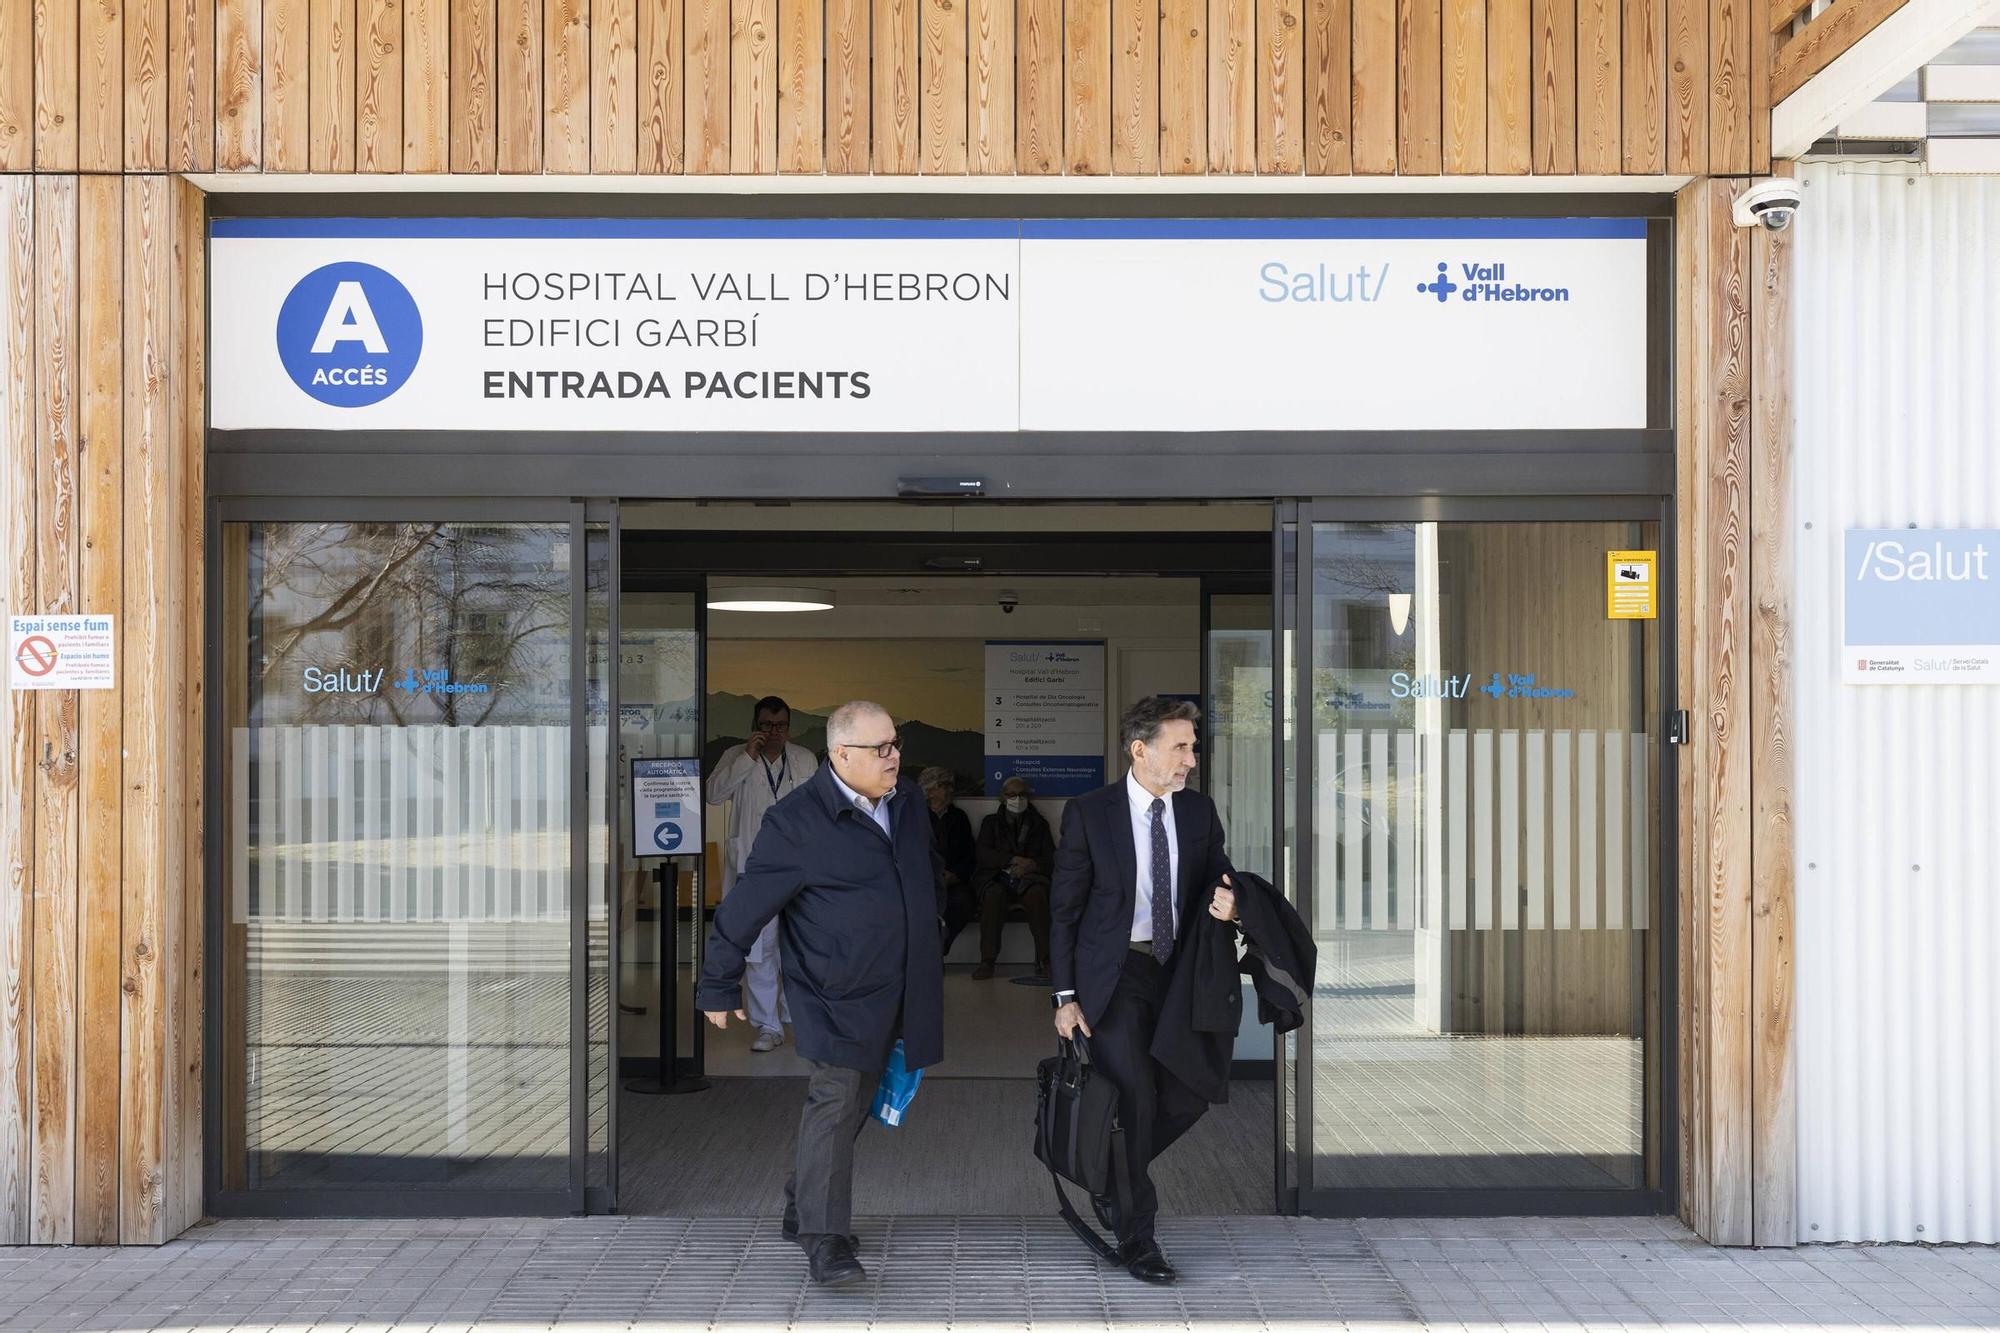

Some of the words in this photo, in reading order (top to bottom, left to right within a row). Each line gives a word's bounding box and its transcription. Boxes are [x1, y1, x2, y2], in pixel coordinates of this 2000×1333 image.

[1462, 263, 1506, 281] Vall
[484, 272, 676, 301] HOSPITAL
[691, 272, 790, 301] VALL
[805, 272, 1009, 301] D'HEBRON
[1258, 262, 1391, 303] Salut/
[1462, 283, 1569, 302] d'Hebron
[310, 280, 390, 354] A
[484, 318, 619, 347] EDIFICI
[636, 312, 760, 347] GARBÍ
[311, 364, 388, 386] ACCÉS
[483, 370, 672, 399] ENTRADA
[684, 370, 871, 399] PACIENTS
[1856, 540, 1990, 582] /Salut
[13, 619, 44, 635] Espai
[47, 621, 81, 632] sense
[84, 619, 109, 631] fum
[60, 652, 82, 660] Espacio
[303, 666, 384, 693] Salut/
[422, 669, 449, 681] Vall
[1508, 674, 1535, 686] Vall
[1390, 673, 1472, 699] Salut/
[995, 696, 1002, 705] 3
[995, 718, 1002, 727] 2
[996, 740, 1001, 749] 1
[994, 771, 1002, 780] 0
